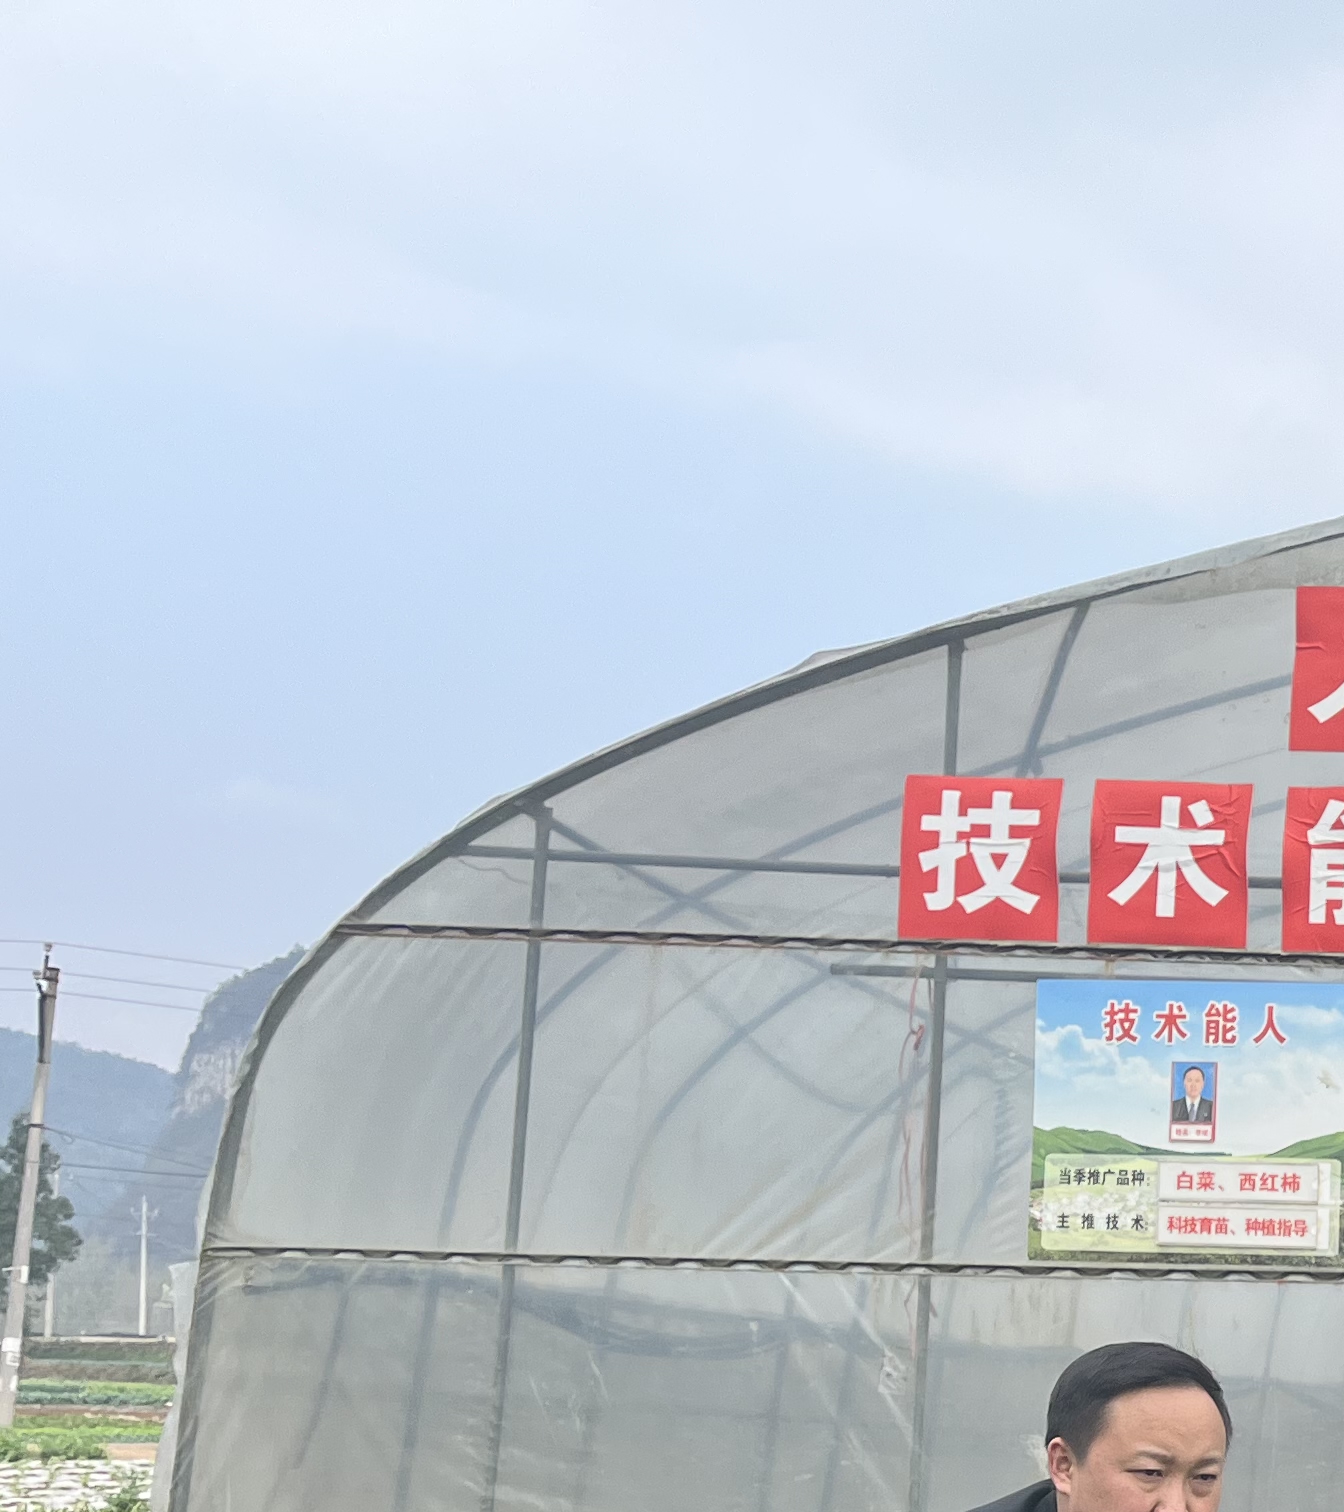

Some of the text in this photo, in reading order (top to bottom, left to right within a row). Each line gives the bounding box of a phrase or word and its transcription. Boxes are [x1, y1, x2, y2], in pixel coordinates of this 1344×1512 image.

[1104, 1002, 1287, 1045] 技术能人
[1175, 1171, 1302, 1193] 白菜、西红柿
[1166, 1215, 1309, 1238] 科技育苗、种植指导
